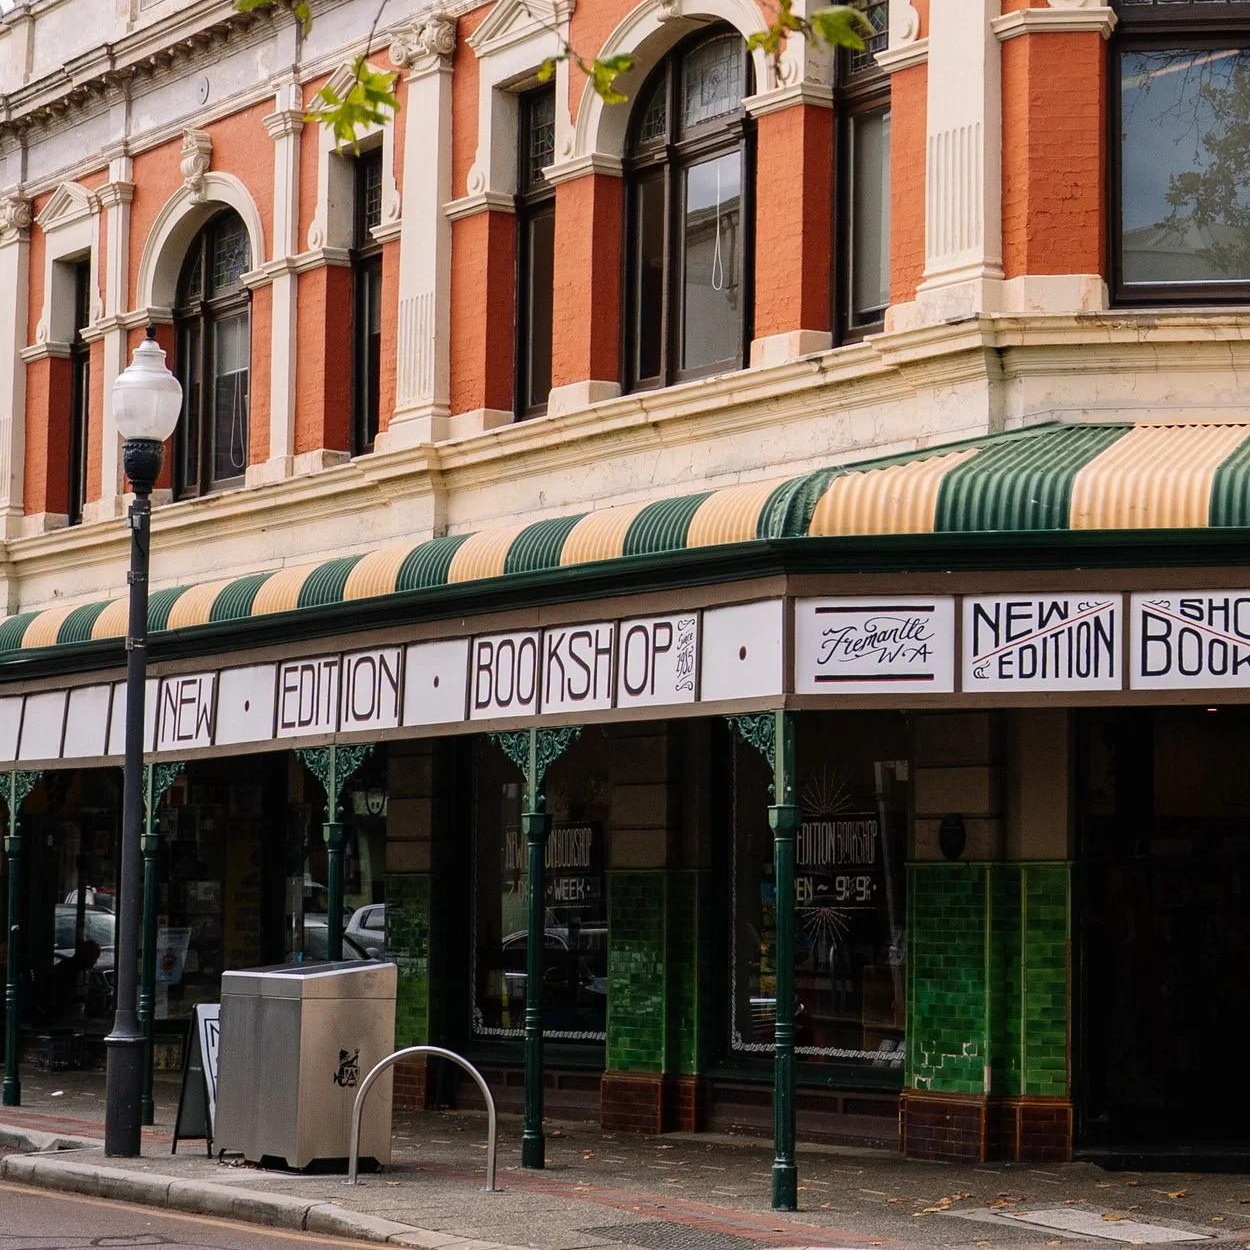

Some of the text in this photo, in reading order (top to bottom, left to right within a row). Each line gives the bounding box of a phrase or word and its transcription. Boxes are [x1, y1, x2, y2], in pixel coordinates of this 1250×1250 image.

[677, 631, 694, 650] Since
[816, 617, 935, 664] Fremantle
[973, 601, 1068, 656] NEW
[998, 609, 1114, 679] EDITION
[162, 622, 673, 743] NEW EDITION BOOKSHOP
[676, 646, 694, 678] 1985
[556, 827, 593, 868] BOOKSHOP
[837, 819, 878, 865] BOOKSHOP
[554, 878, 585, 901] WEEK
